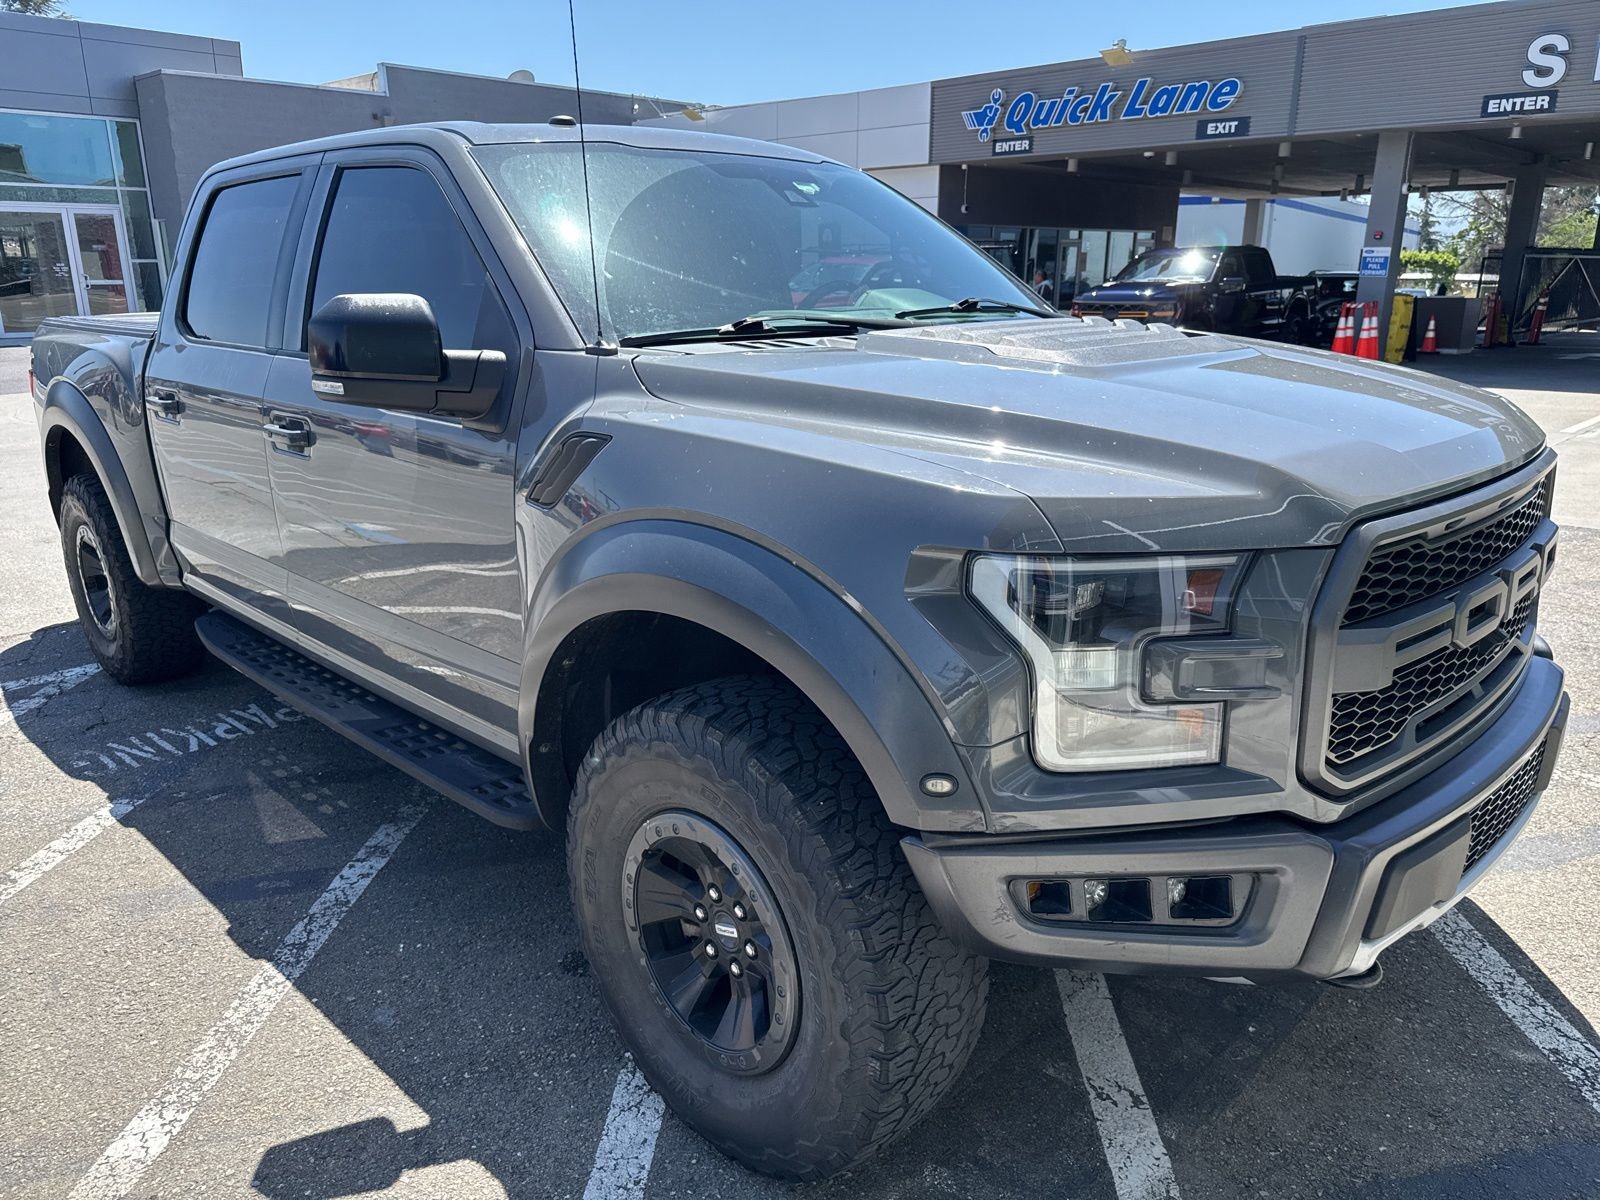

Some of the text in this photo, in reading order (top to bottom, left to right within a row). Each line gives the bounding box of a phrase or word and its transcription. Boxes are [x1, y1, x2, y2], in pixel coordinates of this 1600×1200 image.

[1003, 77, 1242, 135] Quick Lane
[1487, 95, 1551, 113] ENTER
[1206, 121, 1239, 135] EXIT
[995, 139, 1030, 153] ENTER
